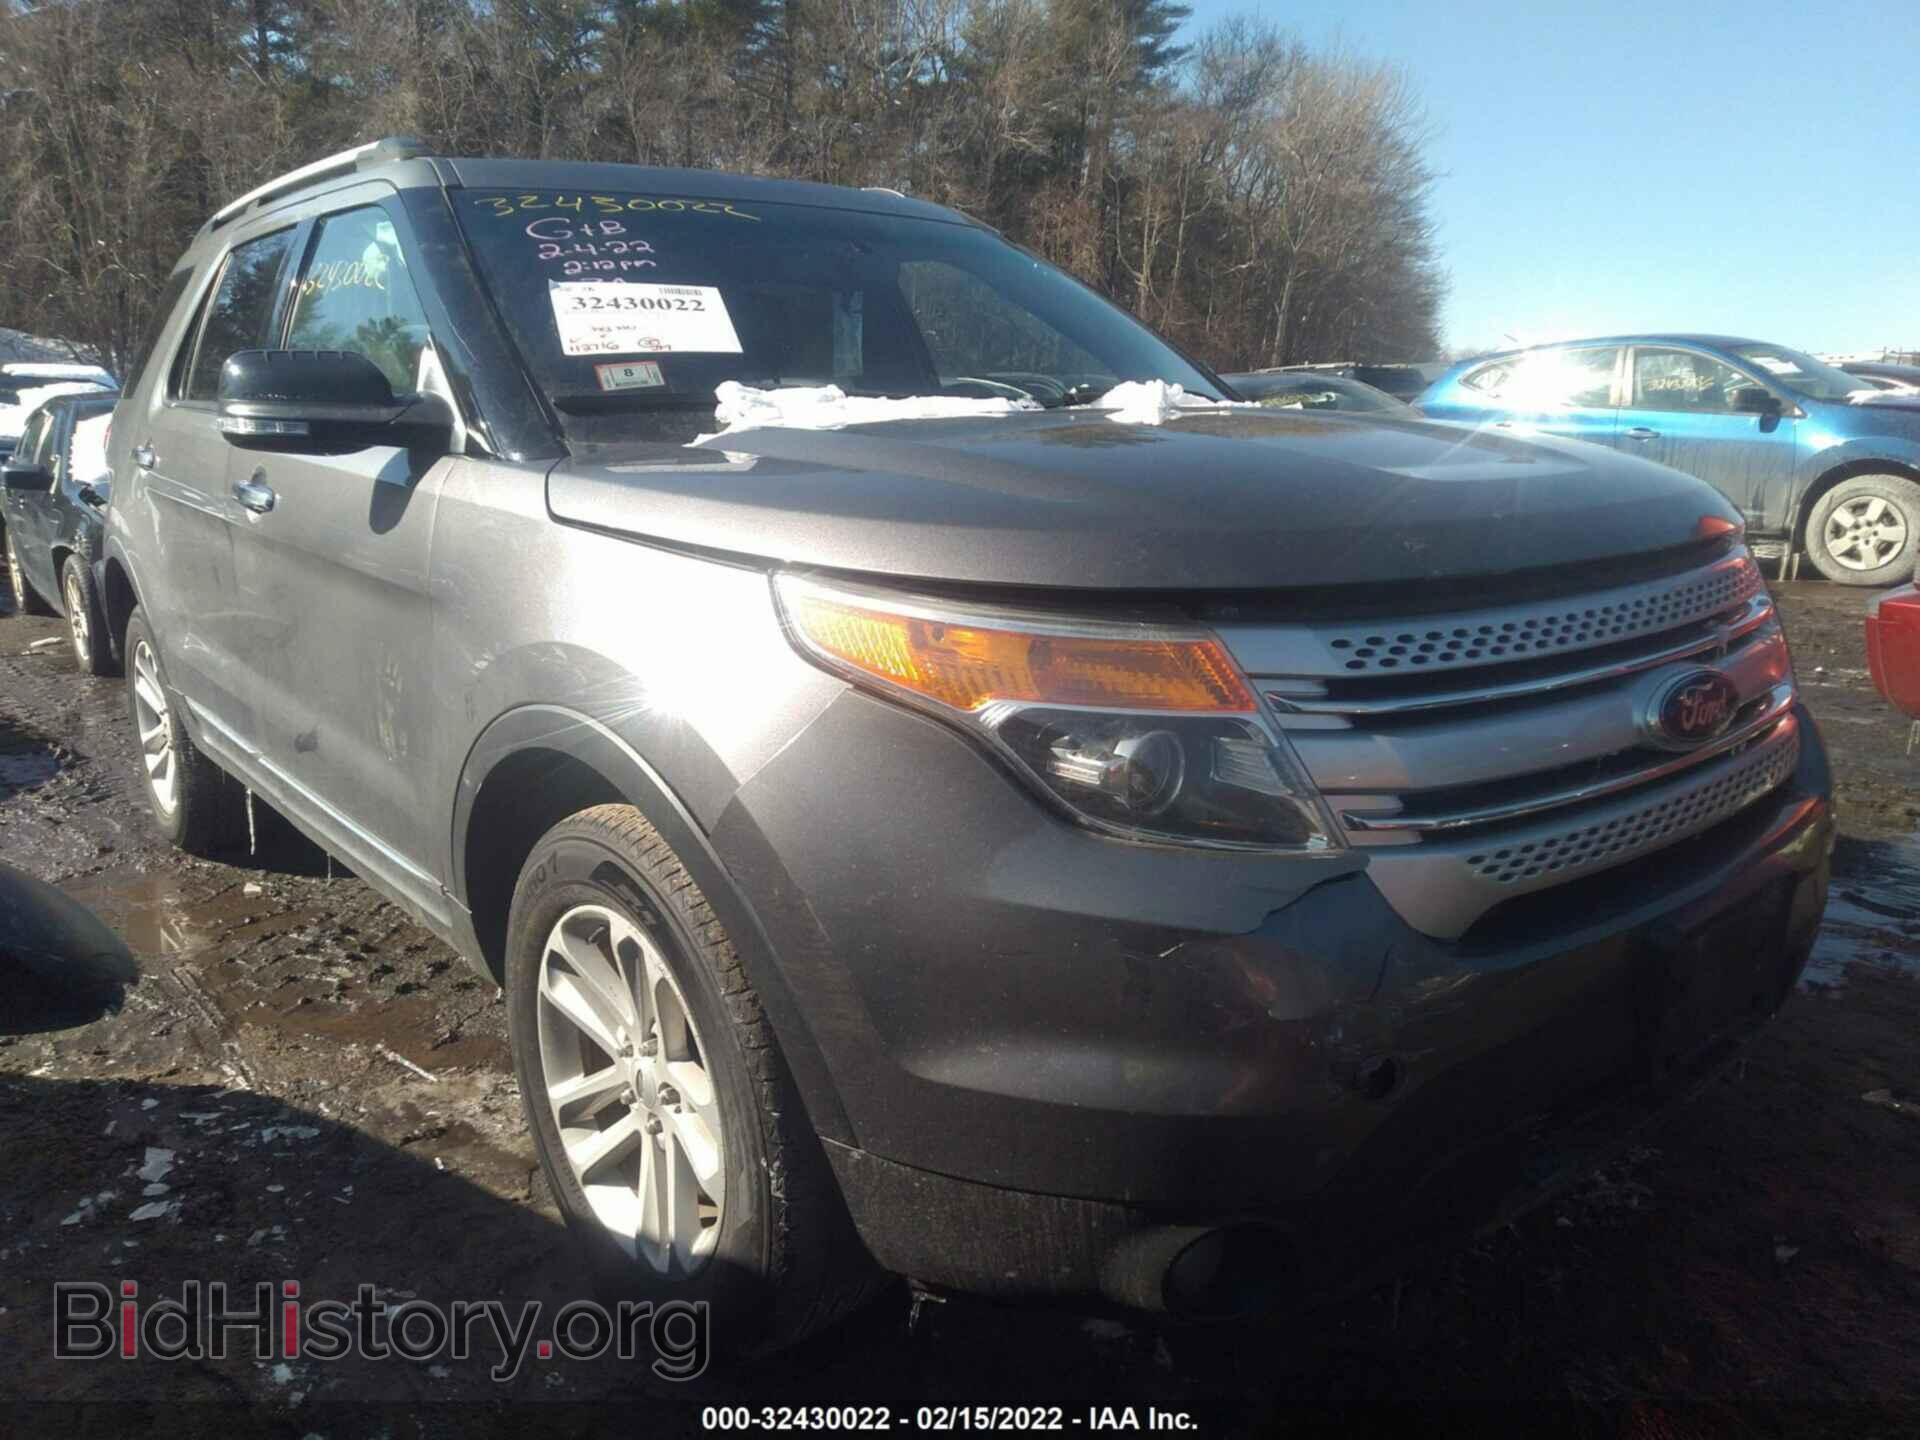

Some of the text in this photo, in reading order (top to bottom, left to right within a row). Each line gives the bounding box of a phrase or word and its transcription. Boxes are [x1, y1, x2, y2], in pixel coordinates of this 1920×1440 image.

[474, 195, 762, 223] 32430022
[538, 239, 656, 261] 2-4-22
[571, 296, 706, 312] 32430022
[623, 367, 635, 378] 8
[1679, 680, 1729, 731] Ford
